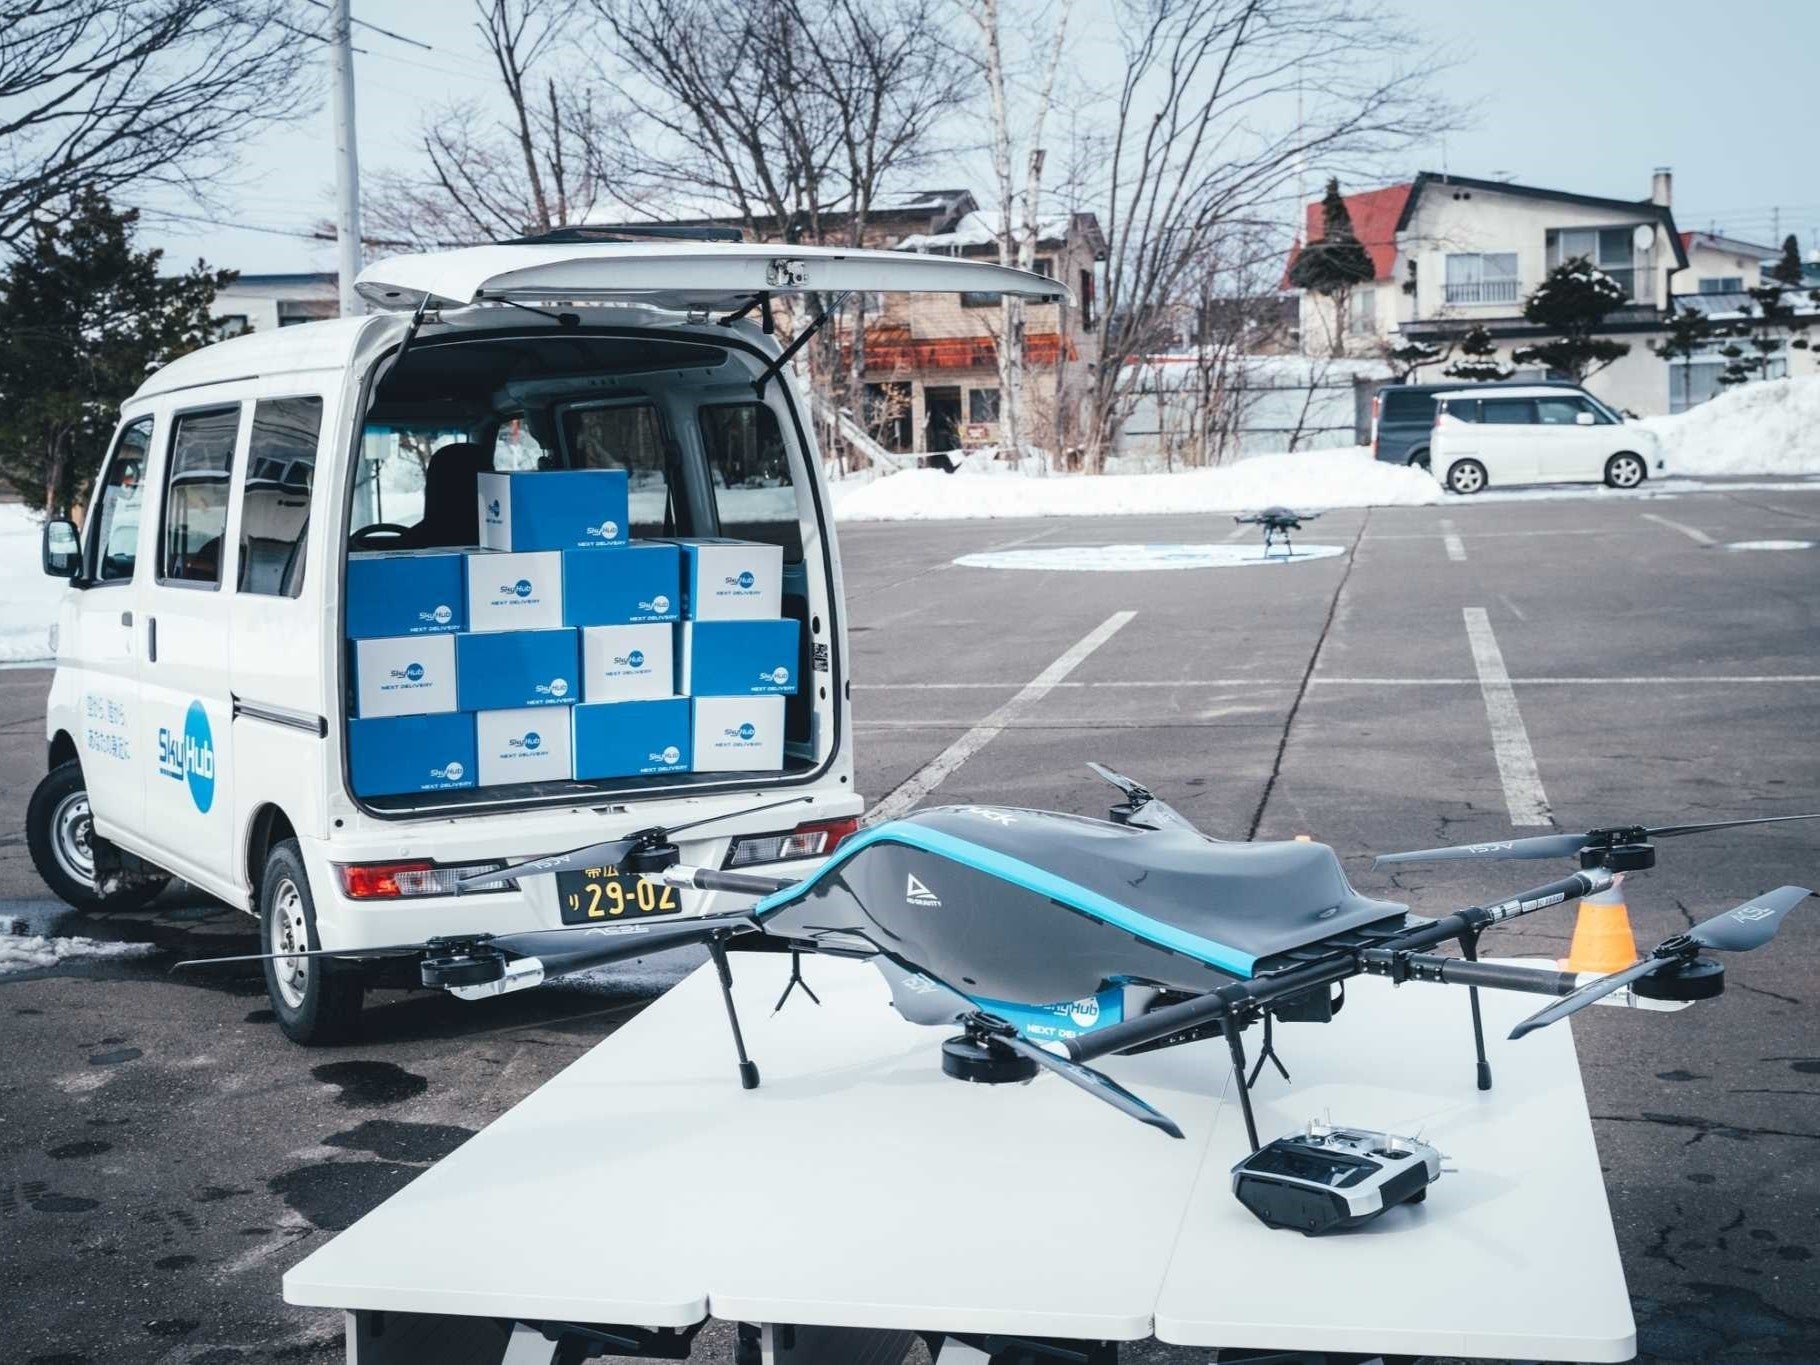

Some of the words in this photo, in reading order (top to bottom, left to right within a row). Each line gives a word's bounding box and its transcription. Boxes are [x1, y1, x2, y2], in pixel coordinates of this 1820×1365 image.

[587, 525, 617, 536] SkyHub
[725, 577, 754, 585] SkyHub
[500, 585, 531, 594] SkyHub
[638, 601, 668, 611] SkyHub
[420, 609, 451, 621] SkyHub
[613, 656, 644, 665] SkyHub
[391, 668, 424, 678] SkyHub
[759, 672, 787, 681] SkyHub
[535, 684, 567, 694] SkyHub
[724, 728, 755, 736] SkyHub
[509, 738, 540, 747] SkyHub
[158, 726, 213, 781] SkyHub
[649, 752, 679, 761] SkyHub
[430, 767, 463, 778] SkyHub
[585, 879, 676, 917] 29-02
[1026, 1024, 1056, 1036] NEXT
